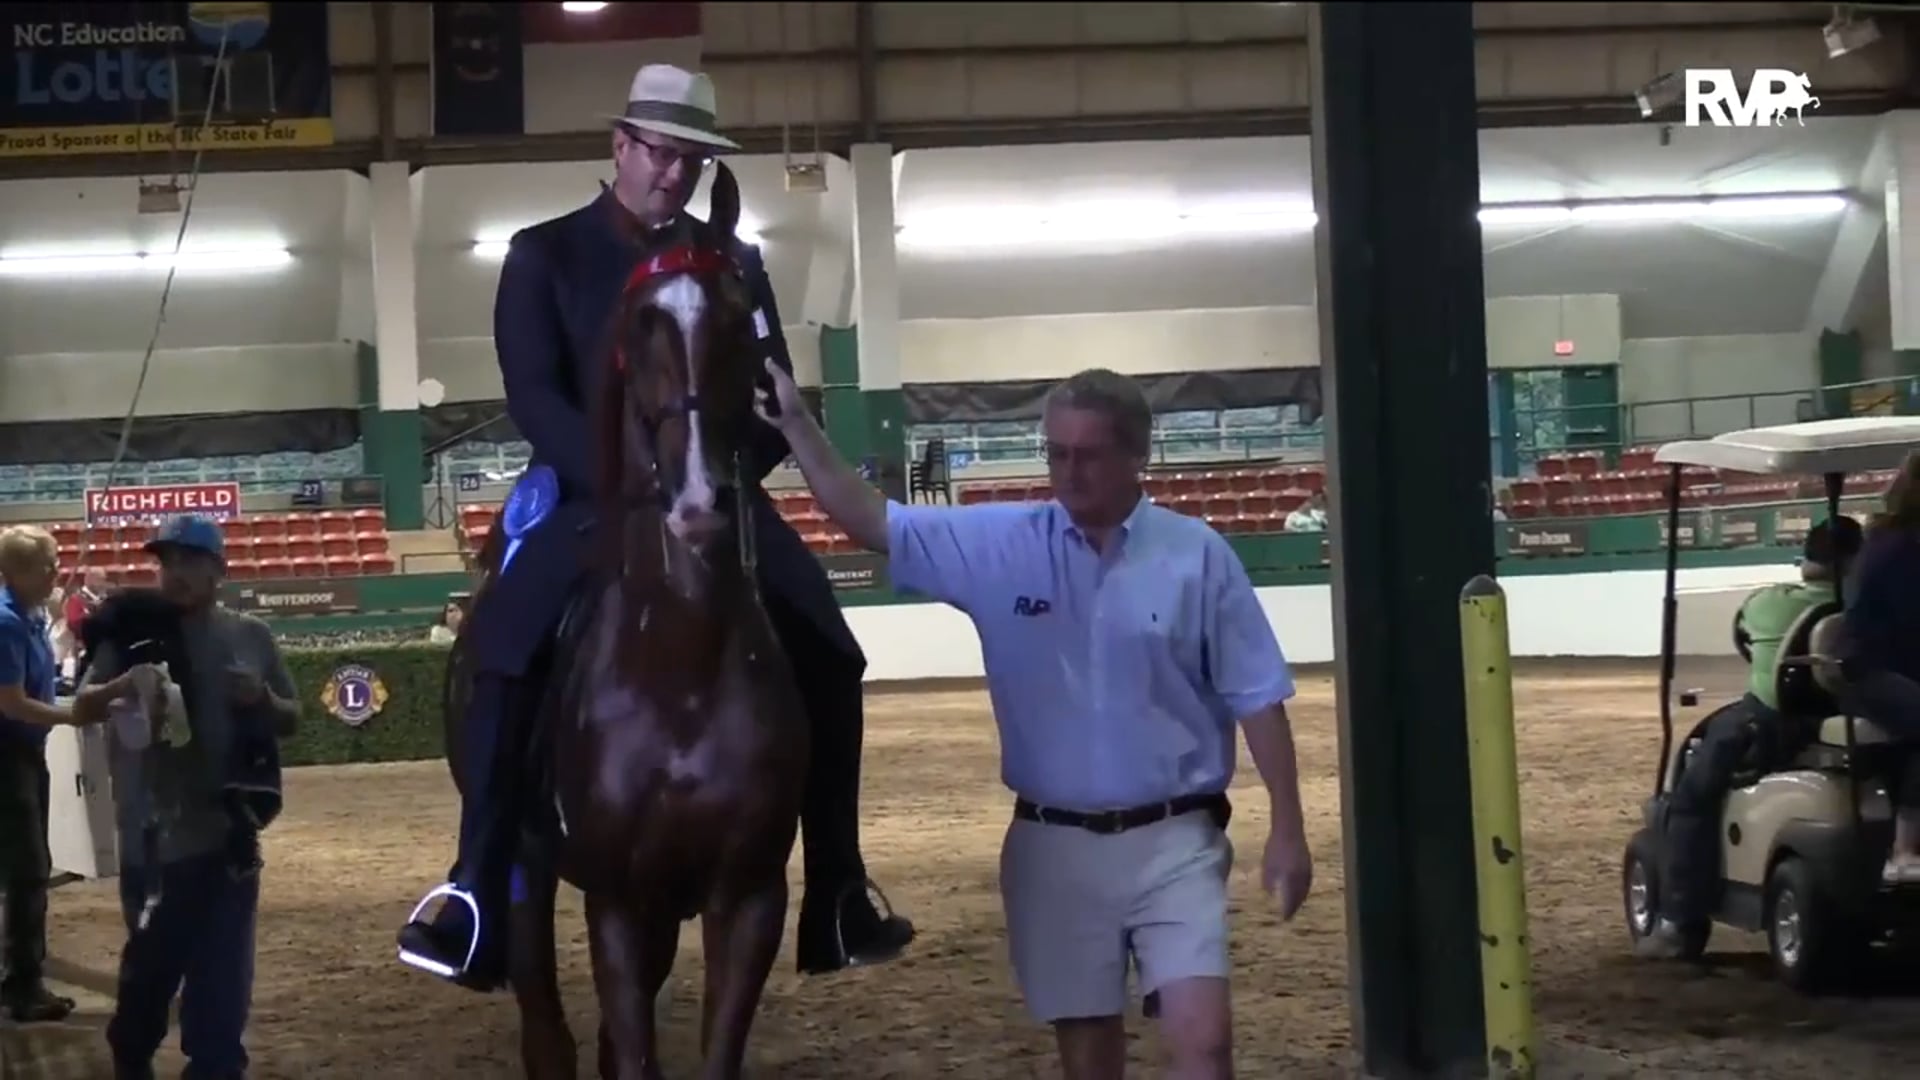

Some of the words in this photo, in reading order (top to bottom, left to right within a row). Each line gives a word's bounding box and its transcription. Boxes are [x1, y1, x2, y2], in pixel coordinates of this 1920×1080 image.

[13, 24, 52, 46] NC
[61, 22, 185, 45] Education
[16, 49, 174, 105] Lotte
[0, 134, 46, 149] Proud
[53, 132, 118, 150] Sponsor
[147, 127, 173, 144] the
[213, 123, 258, 142] State
[264, 121, 297, 140] Fair
[303, 483, 319, 496] 27
[462, 477, 478, 490] 26
[92, 490, 231, 512] RICHFIELD
[344, 683, 364, 708] L
